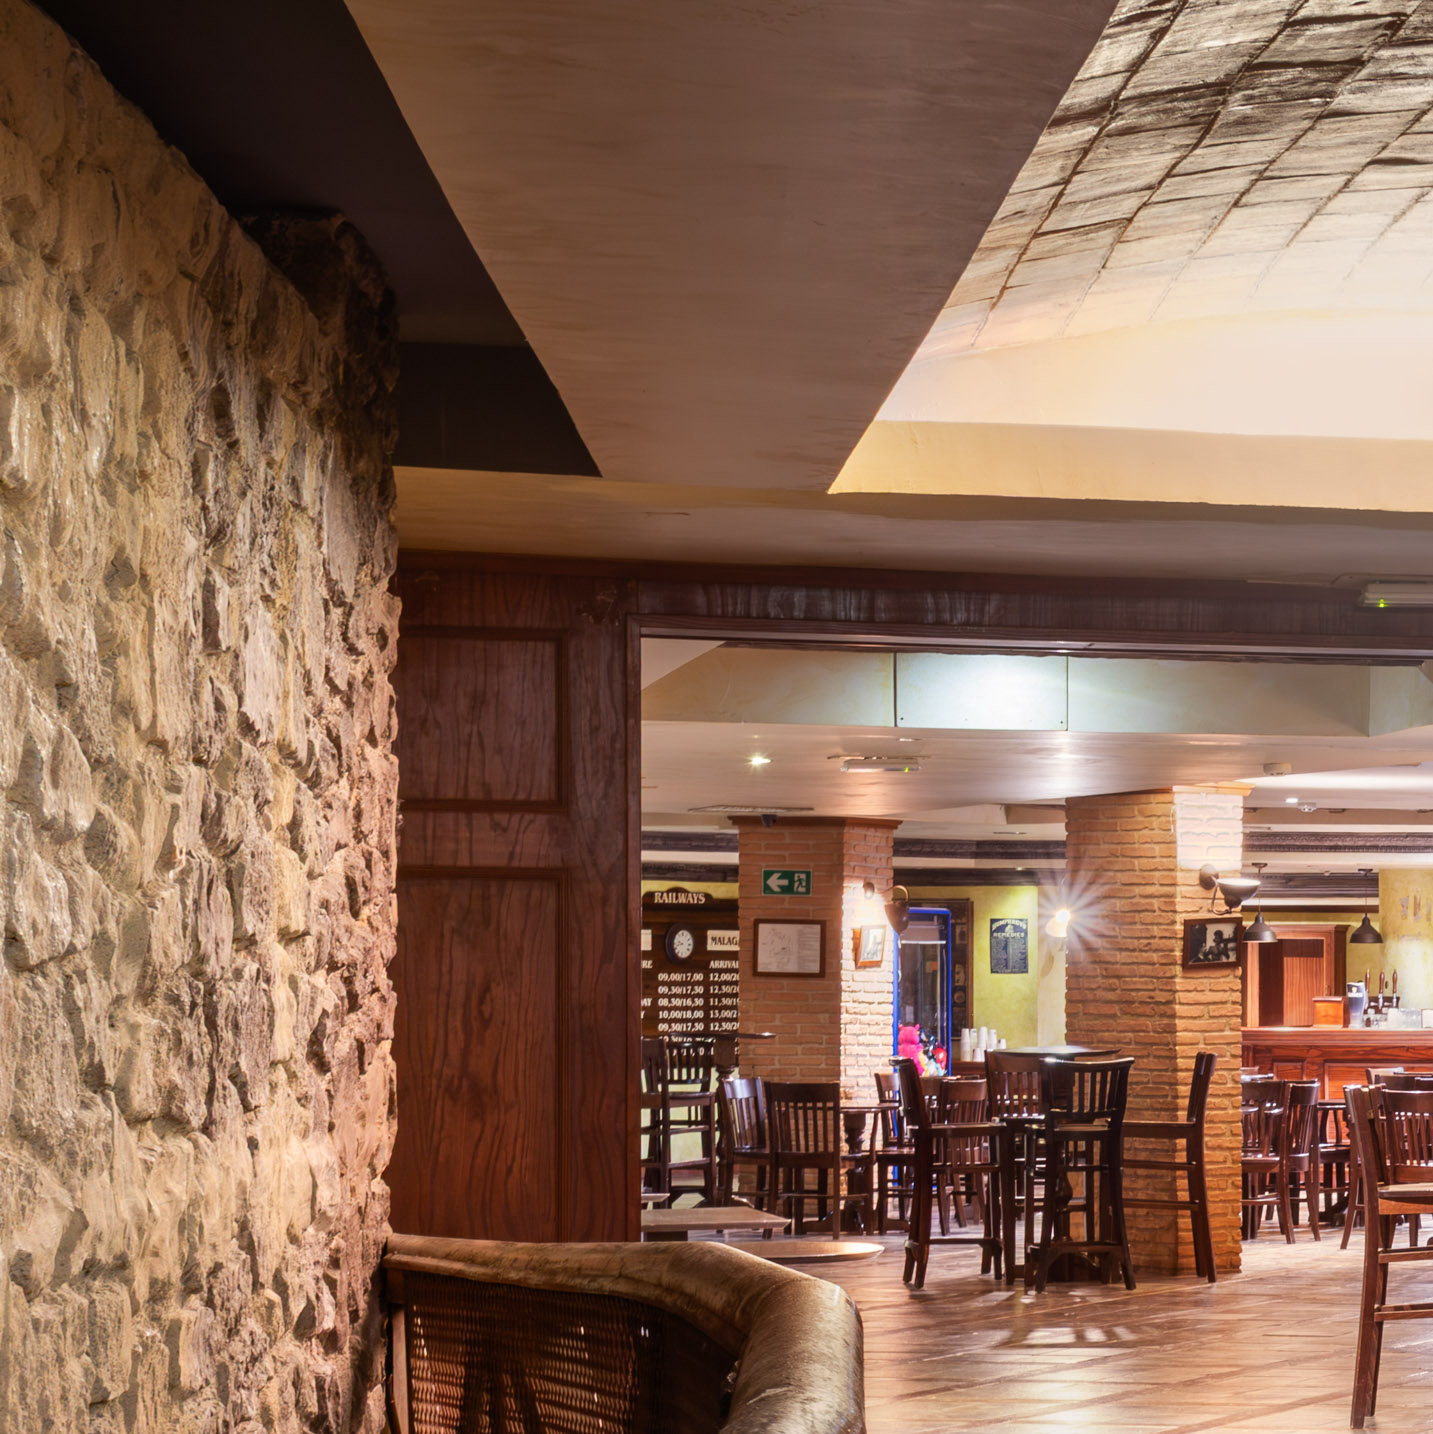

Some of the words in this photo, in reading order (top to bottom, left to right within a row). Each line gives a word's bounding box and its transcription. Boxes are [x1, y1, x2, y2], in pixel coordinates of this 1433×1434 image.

[654, 892, 706, 904] RAILWAYS
[658, 973, 704, 982] 09,00/17,00
[658, 985, 704, 995] 09,30/17,30
[709, 1010, 739, 1019] 13,00/2
